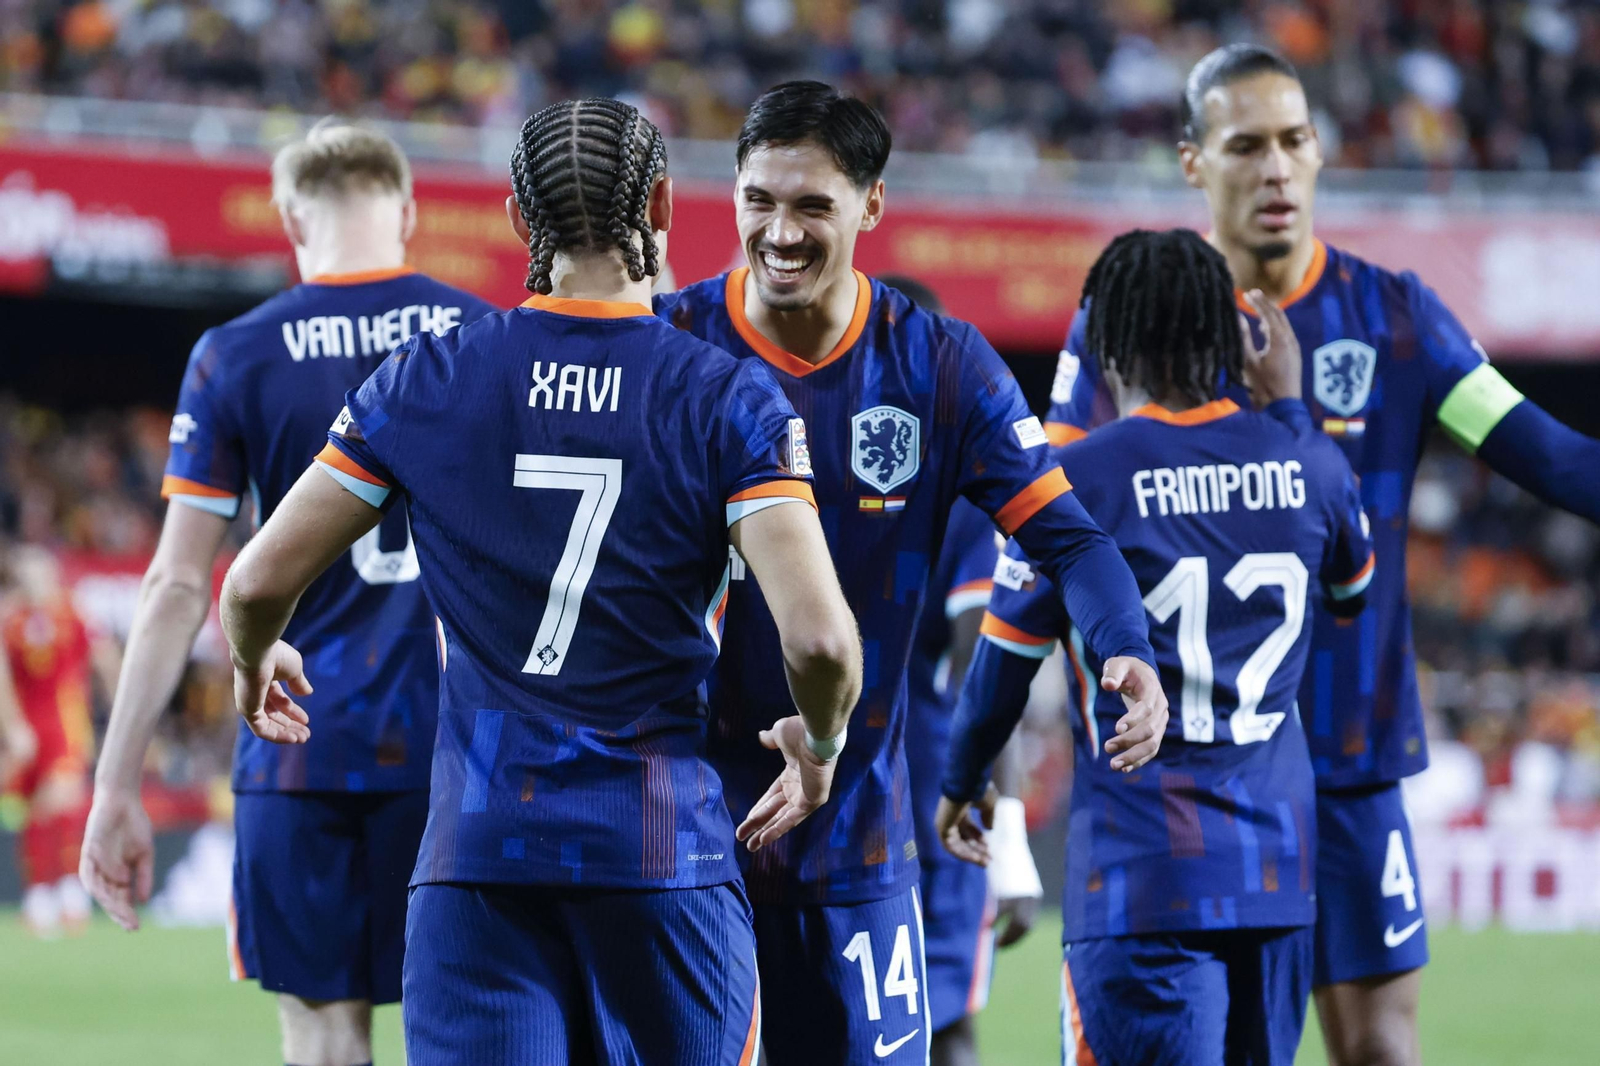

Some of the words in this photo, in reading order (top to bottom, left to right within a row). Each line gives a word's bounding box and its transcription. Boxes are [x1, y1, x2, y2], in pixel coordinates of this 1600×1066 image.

[282, 315, 355, 362] VAN
[528, 361, 622, 412] XAVI
[1132, 460, 1306, 518] FRIMPONG
[513, 453, 623, 676] 7
[1142, 552, 1309, 746] 12
[1381, 829, 1417, 912] 4
[842, 924, 918, 1021] 14
